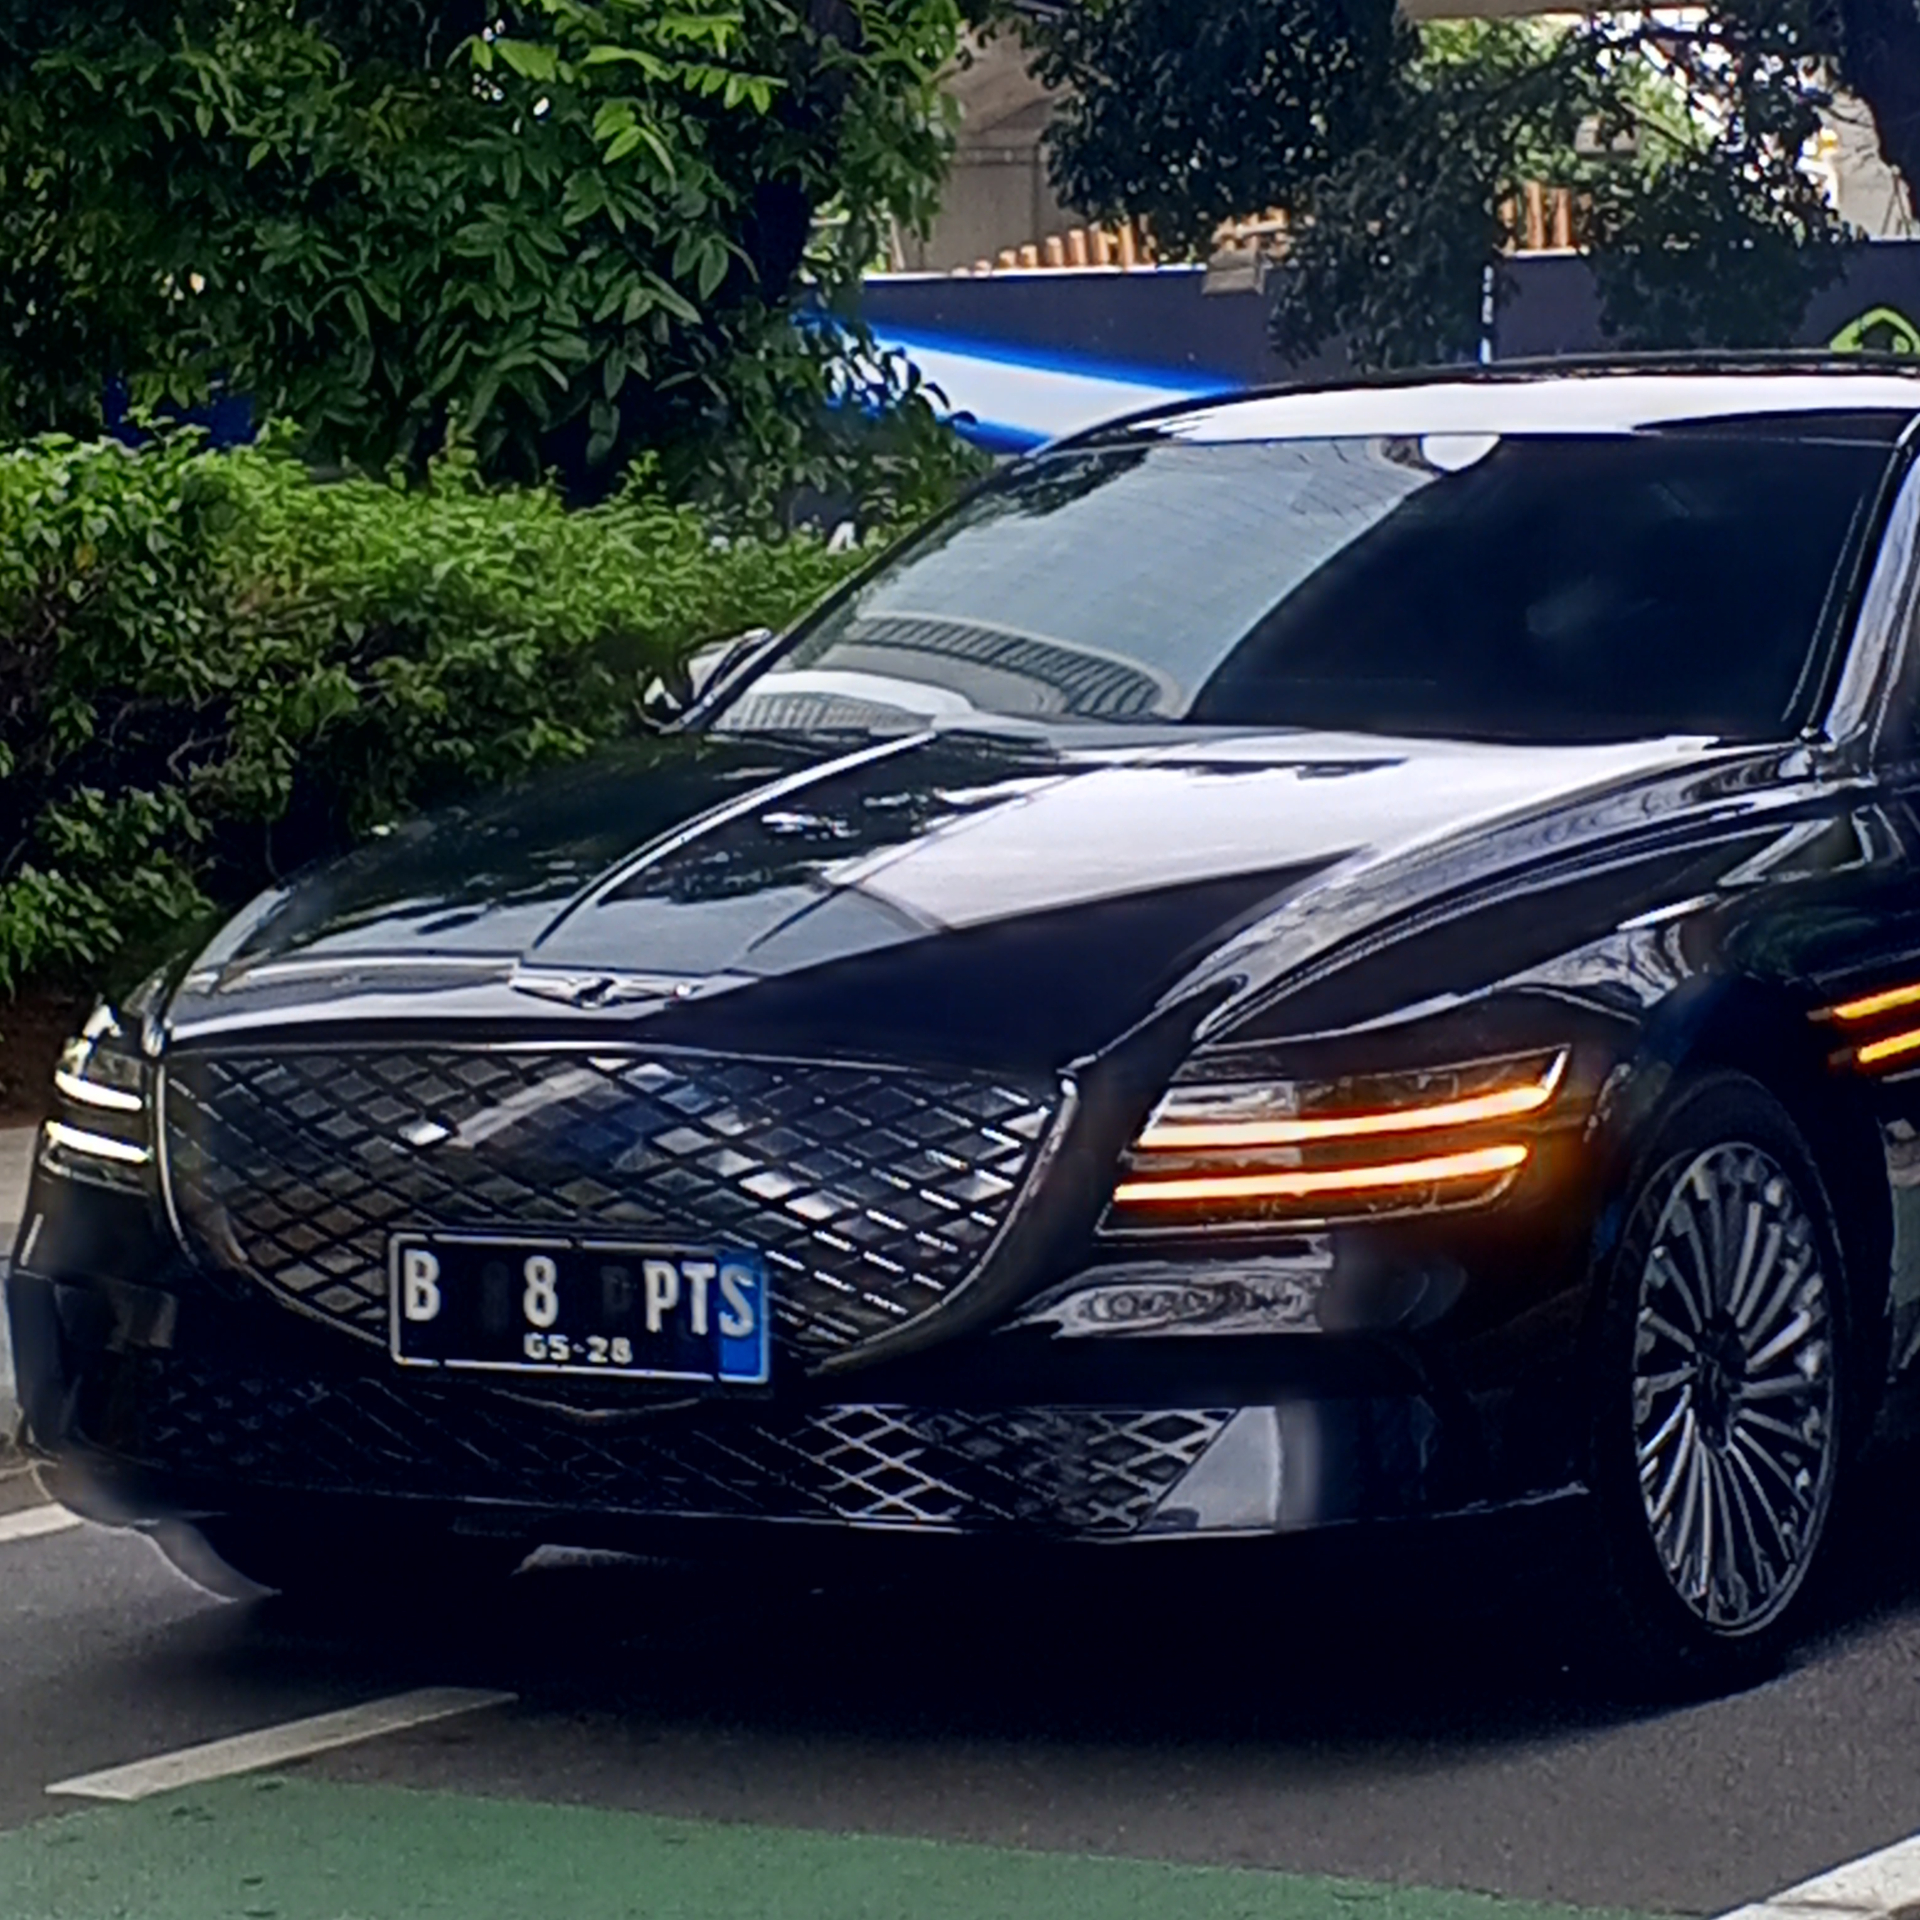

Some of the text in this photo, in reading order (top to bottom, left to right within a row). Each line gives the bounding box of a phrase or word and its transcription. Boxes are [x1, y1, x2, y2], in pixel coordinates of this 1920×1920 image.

[404, 1249, 440, 1321] B
[523, 1255, 559, 1327] 8
[643, 1260, 755, 1337] PTS
